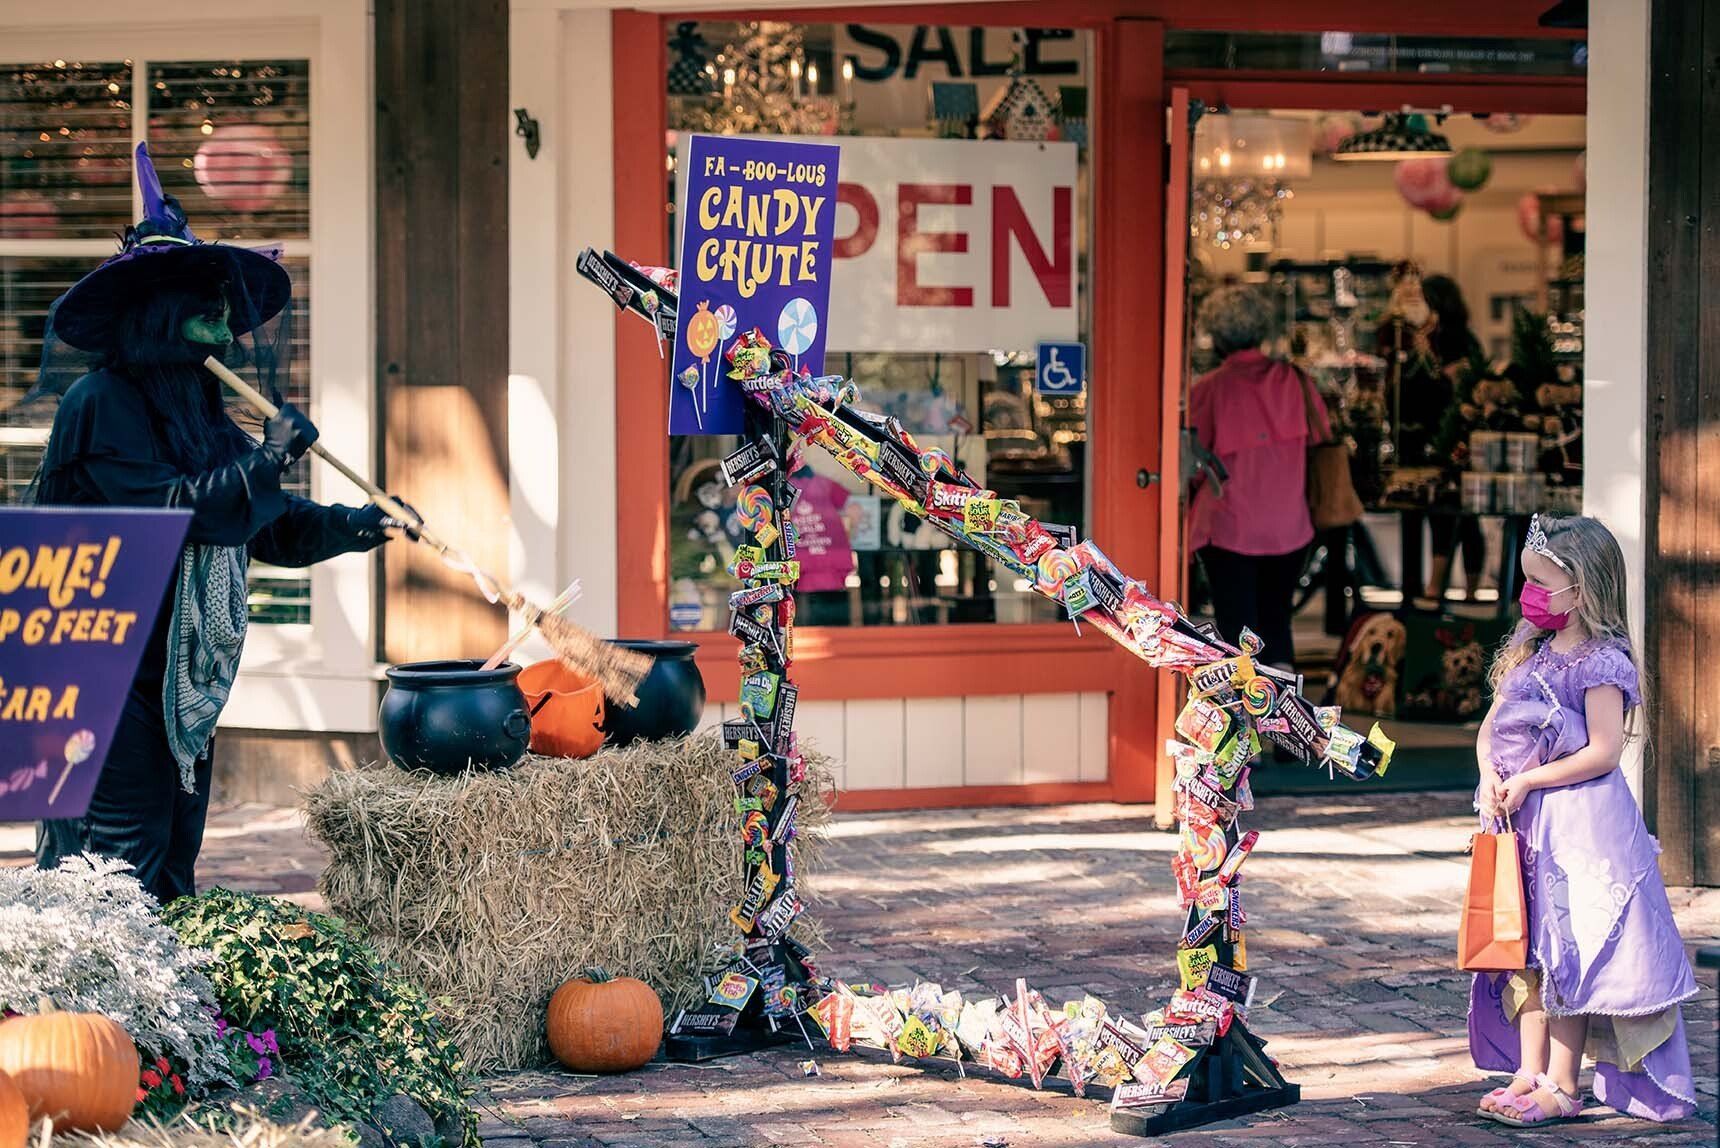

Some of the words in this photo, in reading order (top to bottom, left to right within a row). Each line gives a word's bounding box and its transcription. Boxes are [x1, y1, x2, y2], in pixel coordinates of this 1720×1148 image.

[845, 24, 1078, 81] SALE
[699, 185, 826, 237] CANDY
[586, 254, 619, 292] HERSHEY'S
[696, 238, 820, 298] CHUTE
[726, 445, 760, 475] HERSHEY'S
[883, 447, 917, 486] HERSHEY'S
[23, 608, 52, 646] 6
[50, 610, 137, 645] FEET
[52, 684, 80, 720] A
[780, 690, 797, 738] HERSHEY'S
[1281, 698, 1317, 742] HERSHEY'S
[725, 726, 759, 740] HERSHEY'S
[734, 763, 760, 783] SNICKERS
[1231, 889, 1240, 928] SNICKERS
[1188, 915, 1213, 944] SNICKERS
[1210, 965, 1241, 991] HERSHEY'S
[681, 1014, 720, 1027] HERSHEY'S
[1152, 1025, 1196, 1040] HERSHEY'S
[1120, 1083, 1166, 1098] HERSHEY'S
